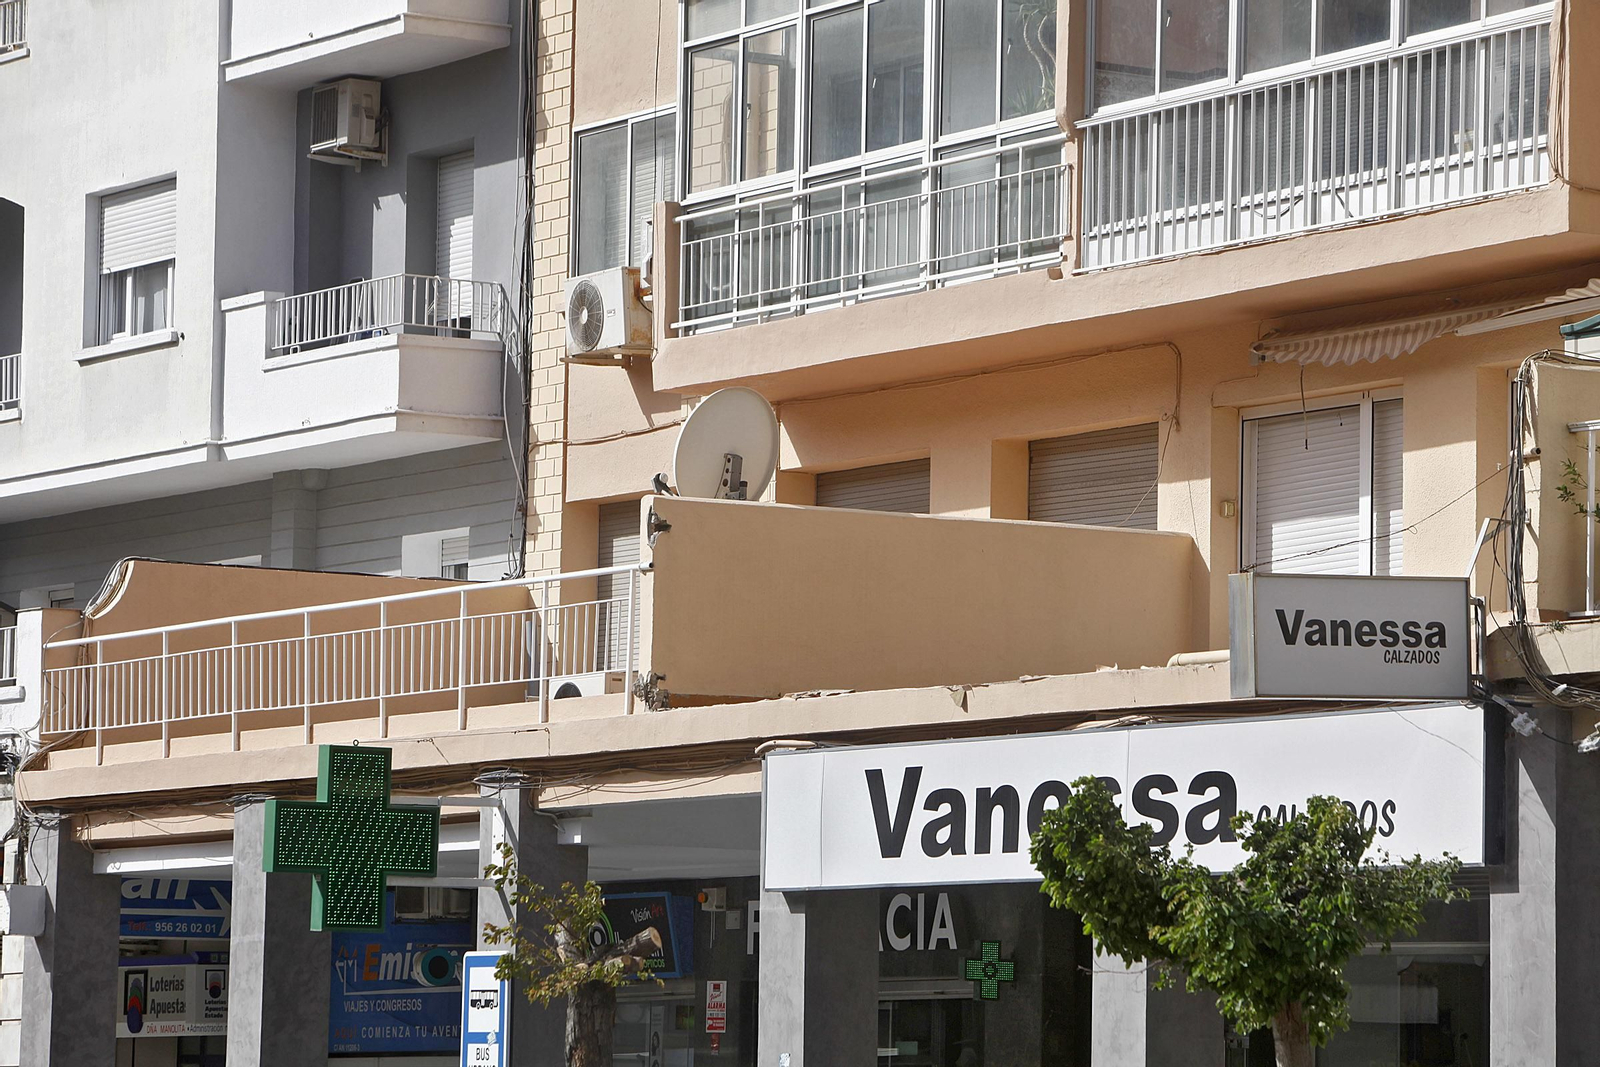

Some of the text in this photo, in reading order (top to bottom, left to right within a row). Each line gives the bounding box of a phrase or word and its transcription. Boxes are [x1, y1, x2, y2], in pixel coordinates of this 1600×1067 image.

[1275, 609, 1447, 648] Vanessa
[1383, 650, 1440, 664] CALZADOS
[155, 922, 173, 932] 956
[175, 923, 188, 932] 26
[190, 923, 203, 933] 02
[205, 924, 216, 933] 01
[150, 975, 184, 992] Loterías
[344, 999, 422, 1012] VIAJES Y CONGRESOS
[361, 1026, 411, 1038] COMIENZA
[415, 1026, 427, 1037] TU
[432, 1025, 461, 1037] AVEN
[476, 1047, 490, 1061] BUS
